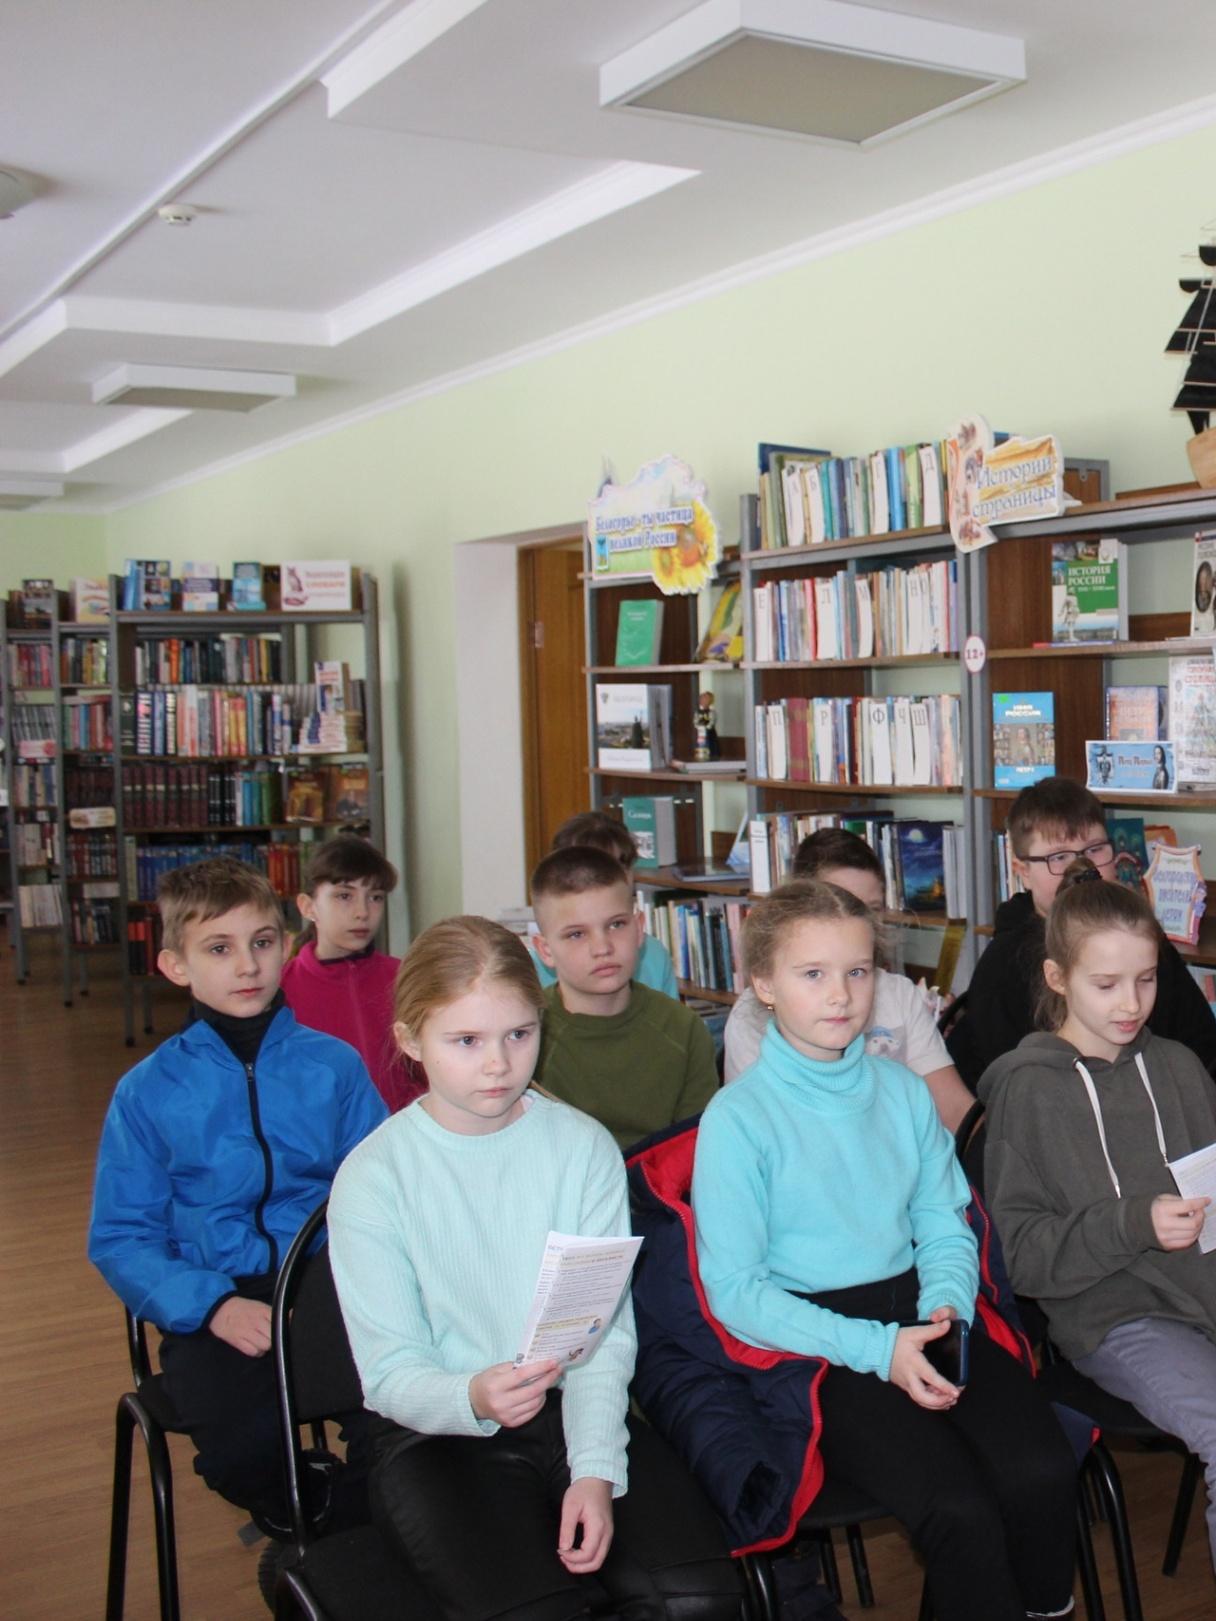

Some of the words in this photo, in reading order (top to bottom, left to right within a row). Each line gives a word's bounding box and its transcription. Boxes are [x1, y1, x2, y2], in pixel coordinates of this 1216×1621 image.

[976, 456, 1053, 489] Истории
[973, 485, 1056, 520] страницы
[1067, 565, 1111, 576] ИСТОРИЯ
[1067, 575, 1106, 586] РОССИИ
[965, 649, 985, 660] 12+
